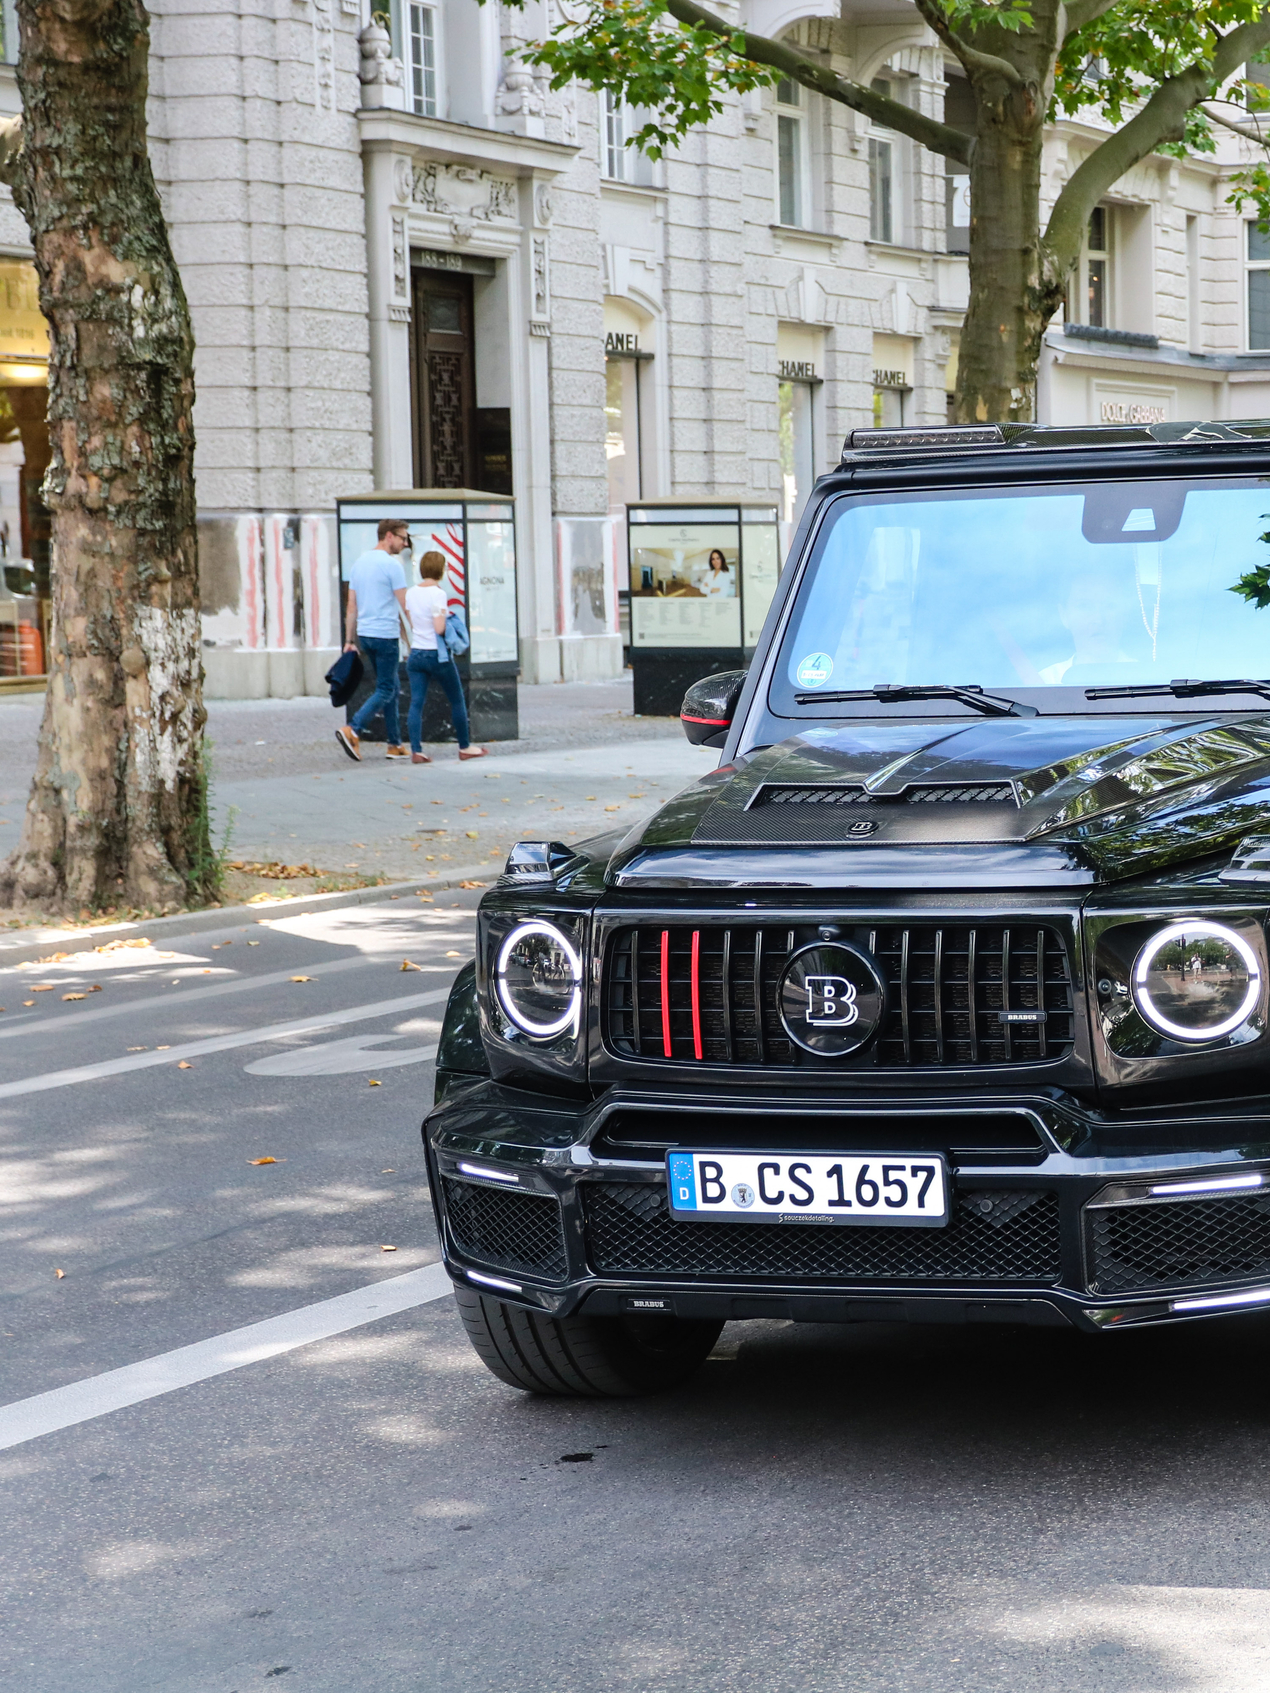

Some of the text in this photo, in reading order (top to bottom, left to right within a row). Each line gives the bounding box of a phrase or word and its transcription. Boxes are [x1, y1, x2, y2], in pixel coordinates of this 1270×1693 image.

[605, 332, 641, 352] ANEL
[811, 655, 822, 671] 4
[698, 1160, 726, 1204] B
[757, 1162, 815, 1207] CS
[826, 1163, 936, 1209] 1657
[679, 1187, 690, 1200] D
[633, 1300, 665, 1308] BRABUS
